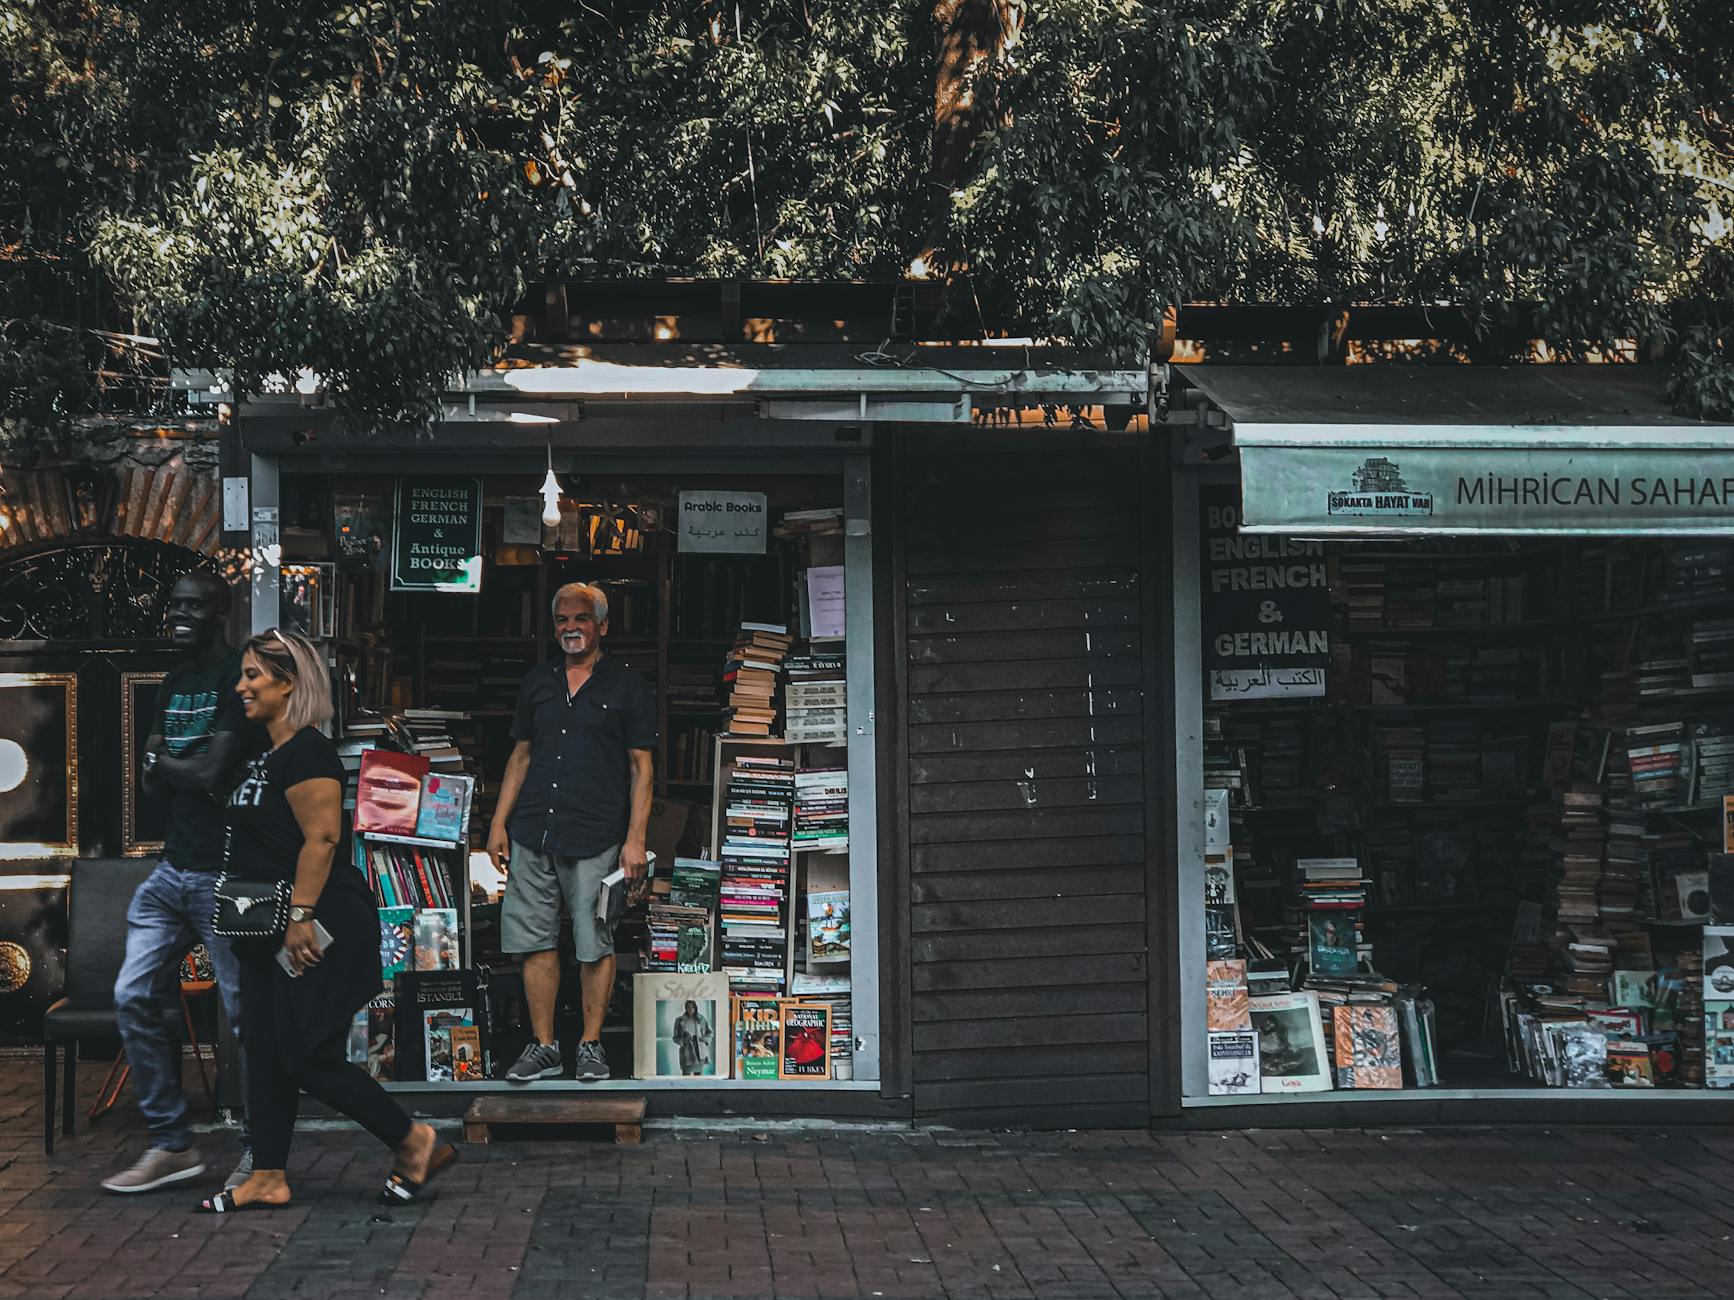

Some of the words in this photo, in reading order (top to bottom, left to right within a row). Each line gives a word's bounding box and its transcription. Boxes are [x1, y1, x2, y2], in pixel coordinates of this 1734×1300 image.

[411, 488, 469, 499] ENGLISH
[1457, 471, 1620, 505] MİHRİCAN
[411, 500, 469, 512] FRENCH
[684, 502, 723, 512] Arabic
[726, 502, 762, 513] Books
[1331, 497, 1373, 508] SOKAKTA
[1375, 495, 1410, 509] HAYAT
[1412, 497, 1430, 508] VAR
[410, 514, 468, 525] GERMAN
[433, 528, 444, 538] &
[688, 526, 725, 539] عربية
[734, 527, 761, 539] كتب
[409, 543, 466, 557] Antique
[1209, 535, 1324, 561] ENGLISH
[409, 557, 467, 571] BOOKS
[1211, 563, 1328, 592] FRENCH
[1258, 600, 1284, 624] &
[1214, 630, 1329, 657] GERMAN
[1214, 667, 1272, 692] العربية
[1276, 667, 1323, 690] الكتب
[786, 1019, 825, 1028] GEOGRAPHIC
